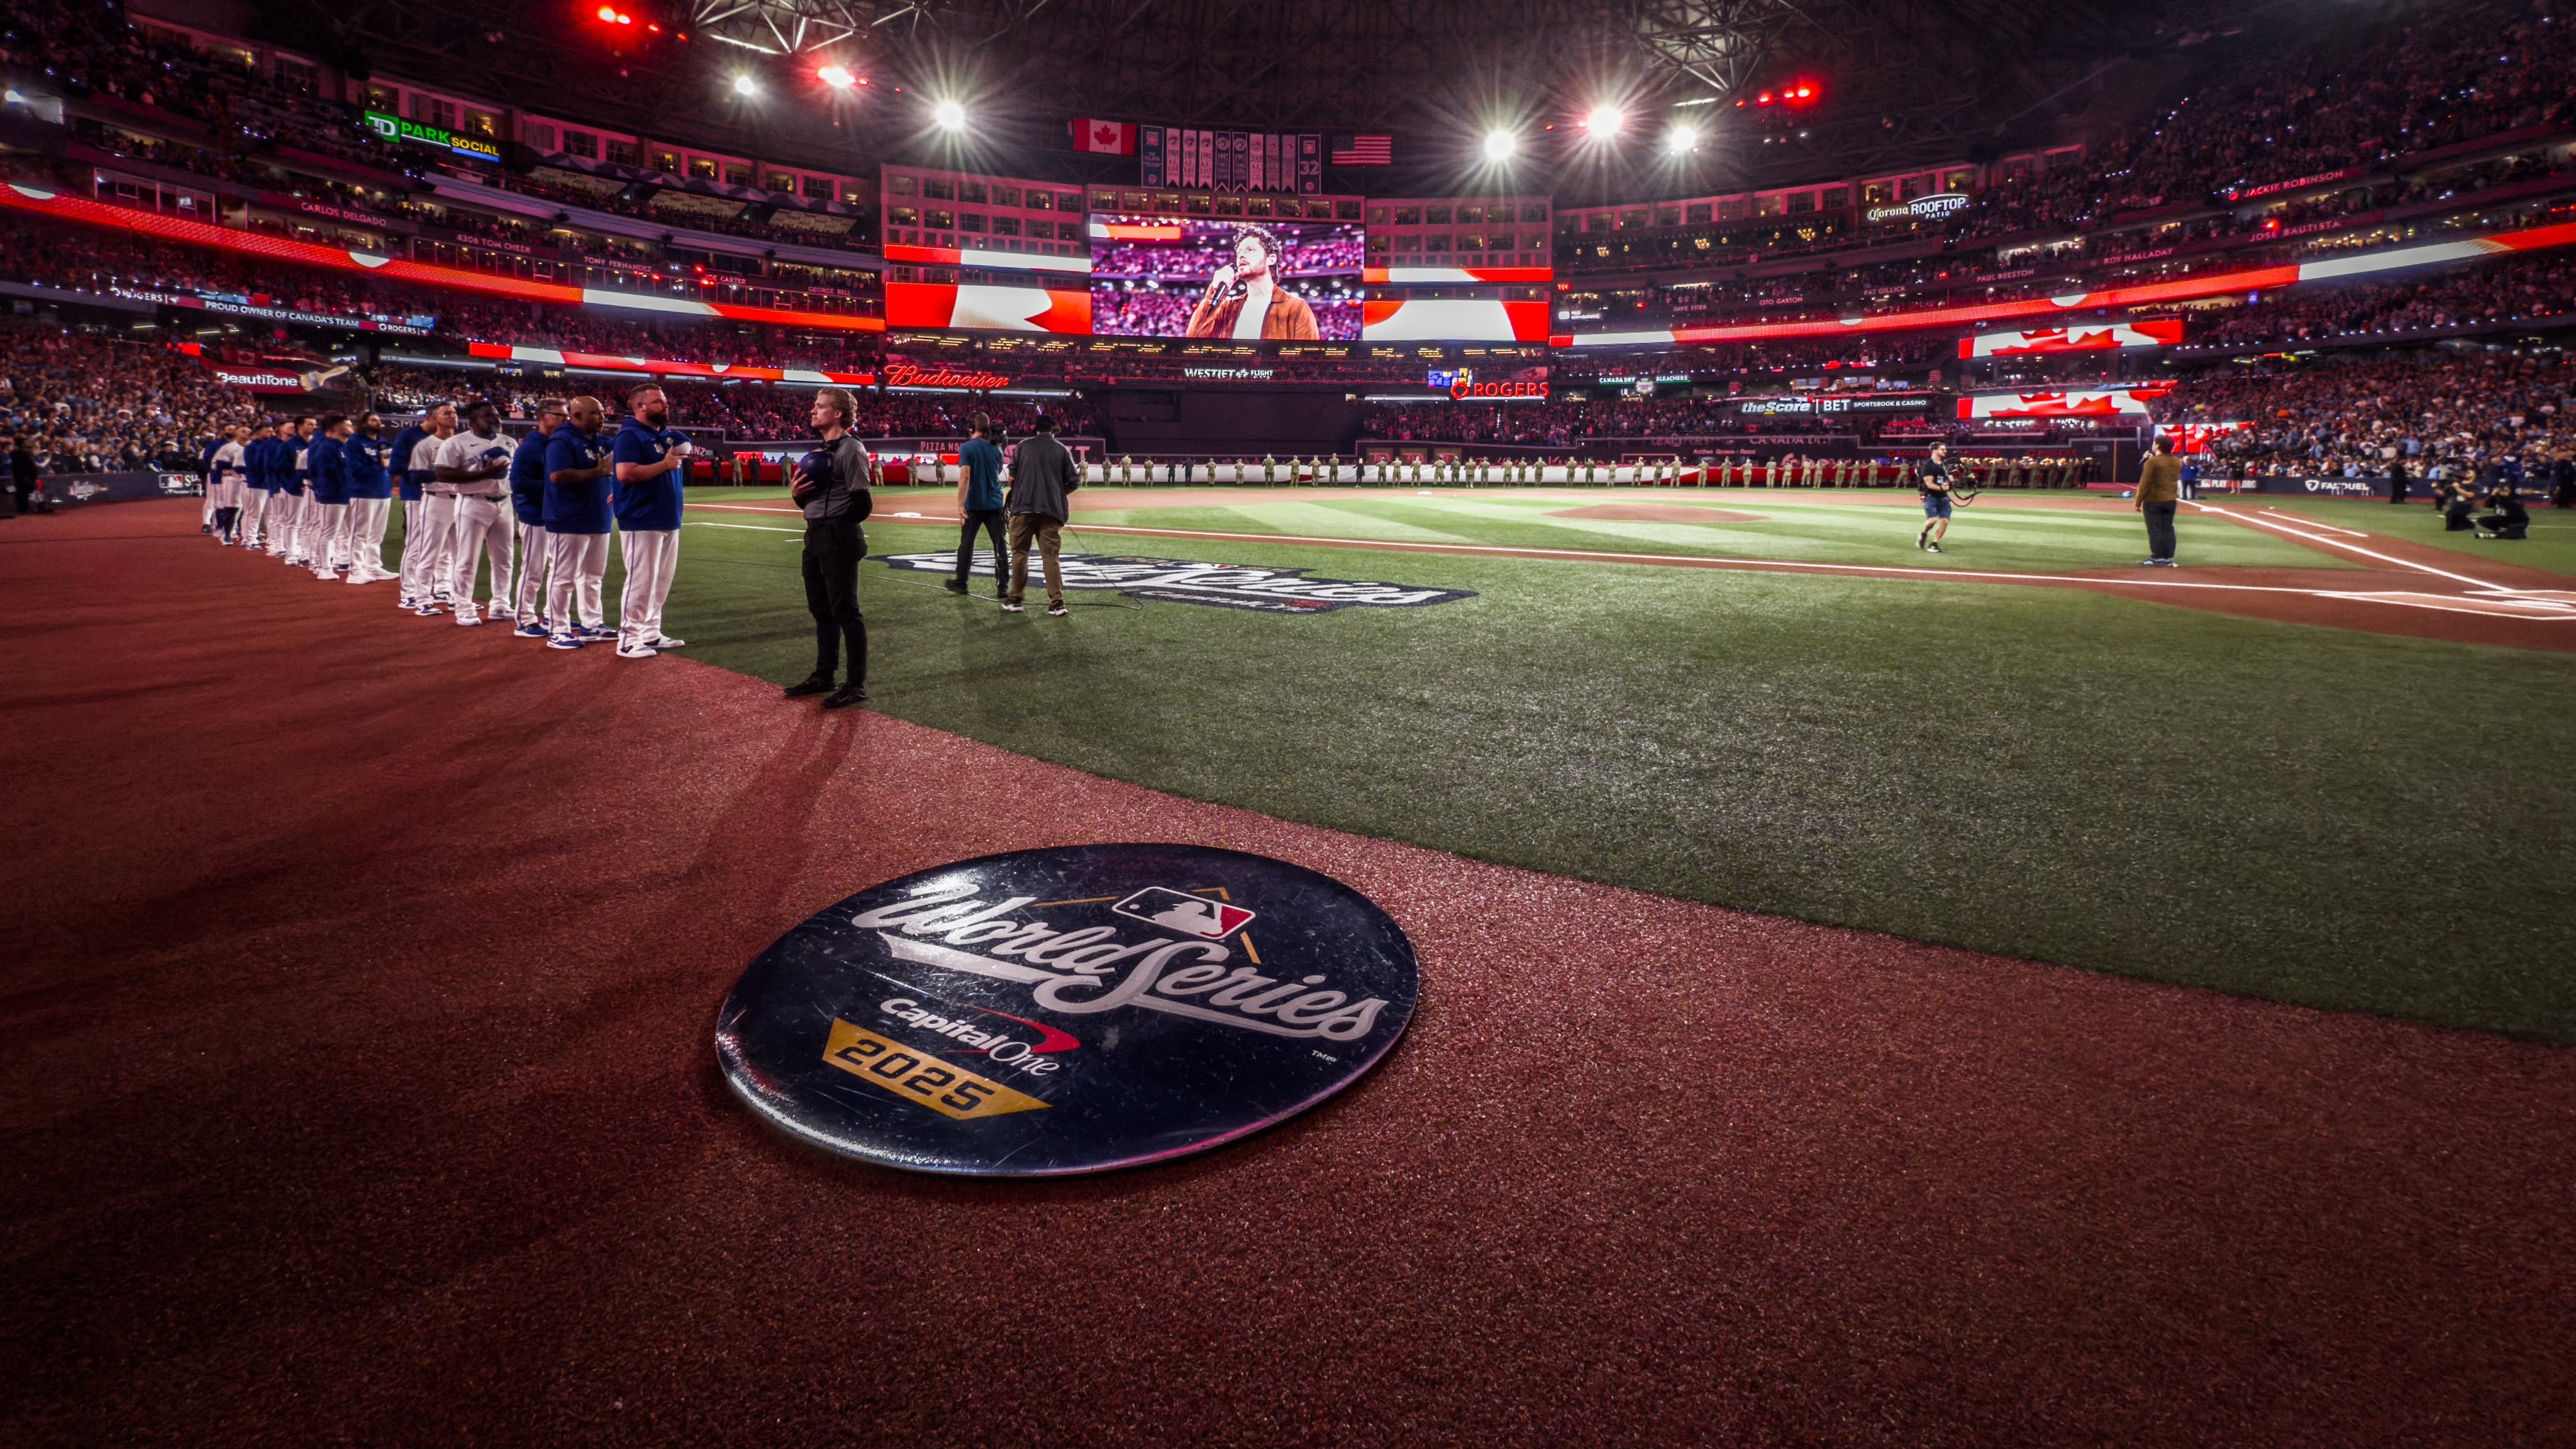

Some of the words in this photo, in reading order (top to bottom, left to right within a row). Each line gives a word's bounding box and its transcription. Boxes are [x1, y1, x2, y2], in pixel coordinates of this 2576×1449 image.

[369, 116, 396, 136] TD
[401, 122, 451, 144] PARK
[451, 137, 501, 156] SOCIAL
[1300, 160, 1319, 175] 32
[2245, 182, 2280, 197] JACKIE
[2284, 170, 2345, 189] ROBINSON
[301, 202, 340, 217] CARLOS
[343, 211, 387, 226] DELGADO
[1868, 206, 1909, 221] Corona
[1911, 197, 1966, 215] ROOFTOP
[1926, 211, 1950, 219] PATIO
[2284, 221, 2341, 236] BAUTISTA
[481, 238, 502, 248] TOM
[504, 243, 531, 253] CHEEK
[584, 256, 606, 265] TONY
[609, 260, 652, 272] FERNANDEZ
[2104, 256, 2121, 265] ROY
[2124, 248, 2174, 262] HALLADAY
[720, 276, 747, 285] CARTER
[1977, 273, 1996, 282] PAUL
[1997, 269, 2035, 279] BEESTON
[808, 286, 834, 294] GEORGE
[1878, 286, 1906, 294] GILLICK
[204, 301, 238, 312] PROUD
[240, 306, 274, 316] OWNER
[289, 313, 333, 325] CANADA'S
[335, 318, 359, 327] TEAM
[388, 325, 416, 334] ROGERS
[217, 372, 298, 386] BeautiTone
[884, 365, 1011, 388] Budweiser
[1474, 382, 1550, 397] ROGERS
[1741, 402, 1811, 413] theScore
[1823, 399, 1850, 411] BET
[920, 441, 945, 452] PIZZA
[852, 882, 1174, 981] World
[1033, 941, 1389, 1041] Series
[835, 1039, 996, 1111] 2025
